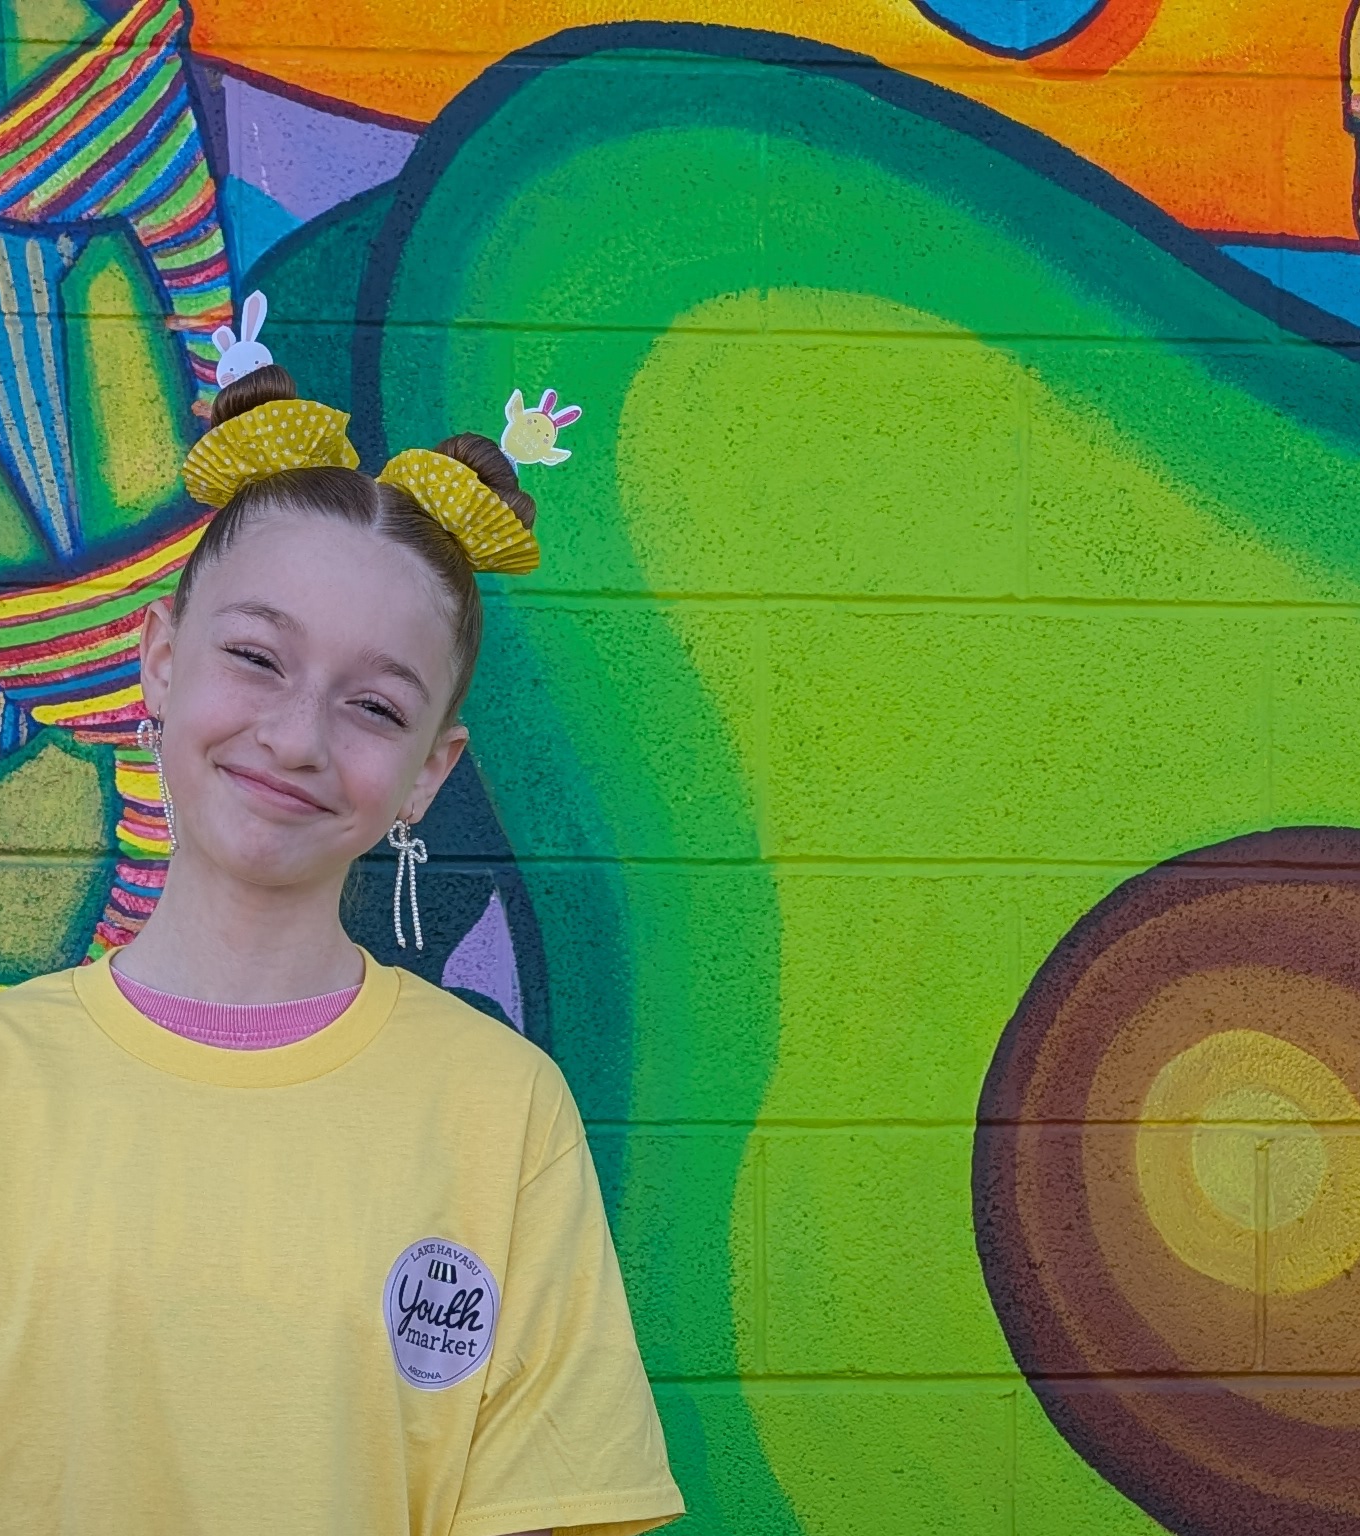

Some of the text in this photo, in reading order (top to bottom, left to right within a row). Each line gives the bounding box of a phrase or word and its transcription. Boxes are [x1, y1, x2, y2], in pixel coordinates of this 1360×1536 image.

[410, 1243, 482, 1276] LAKE HAVASU
[397, 1274, 484, 1337] Youth
[405, 1327, 478, 1357] market
[407, 1365, 442, 1380] ARIZONA
